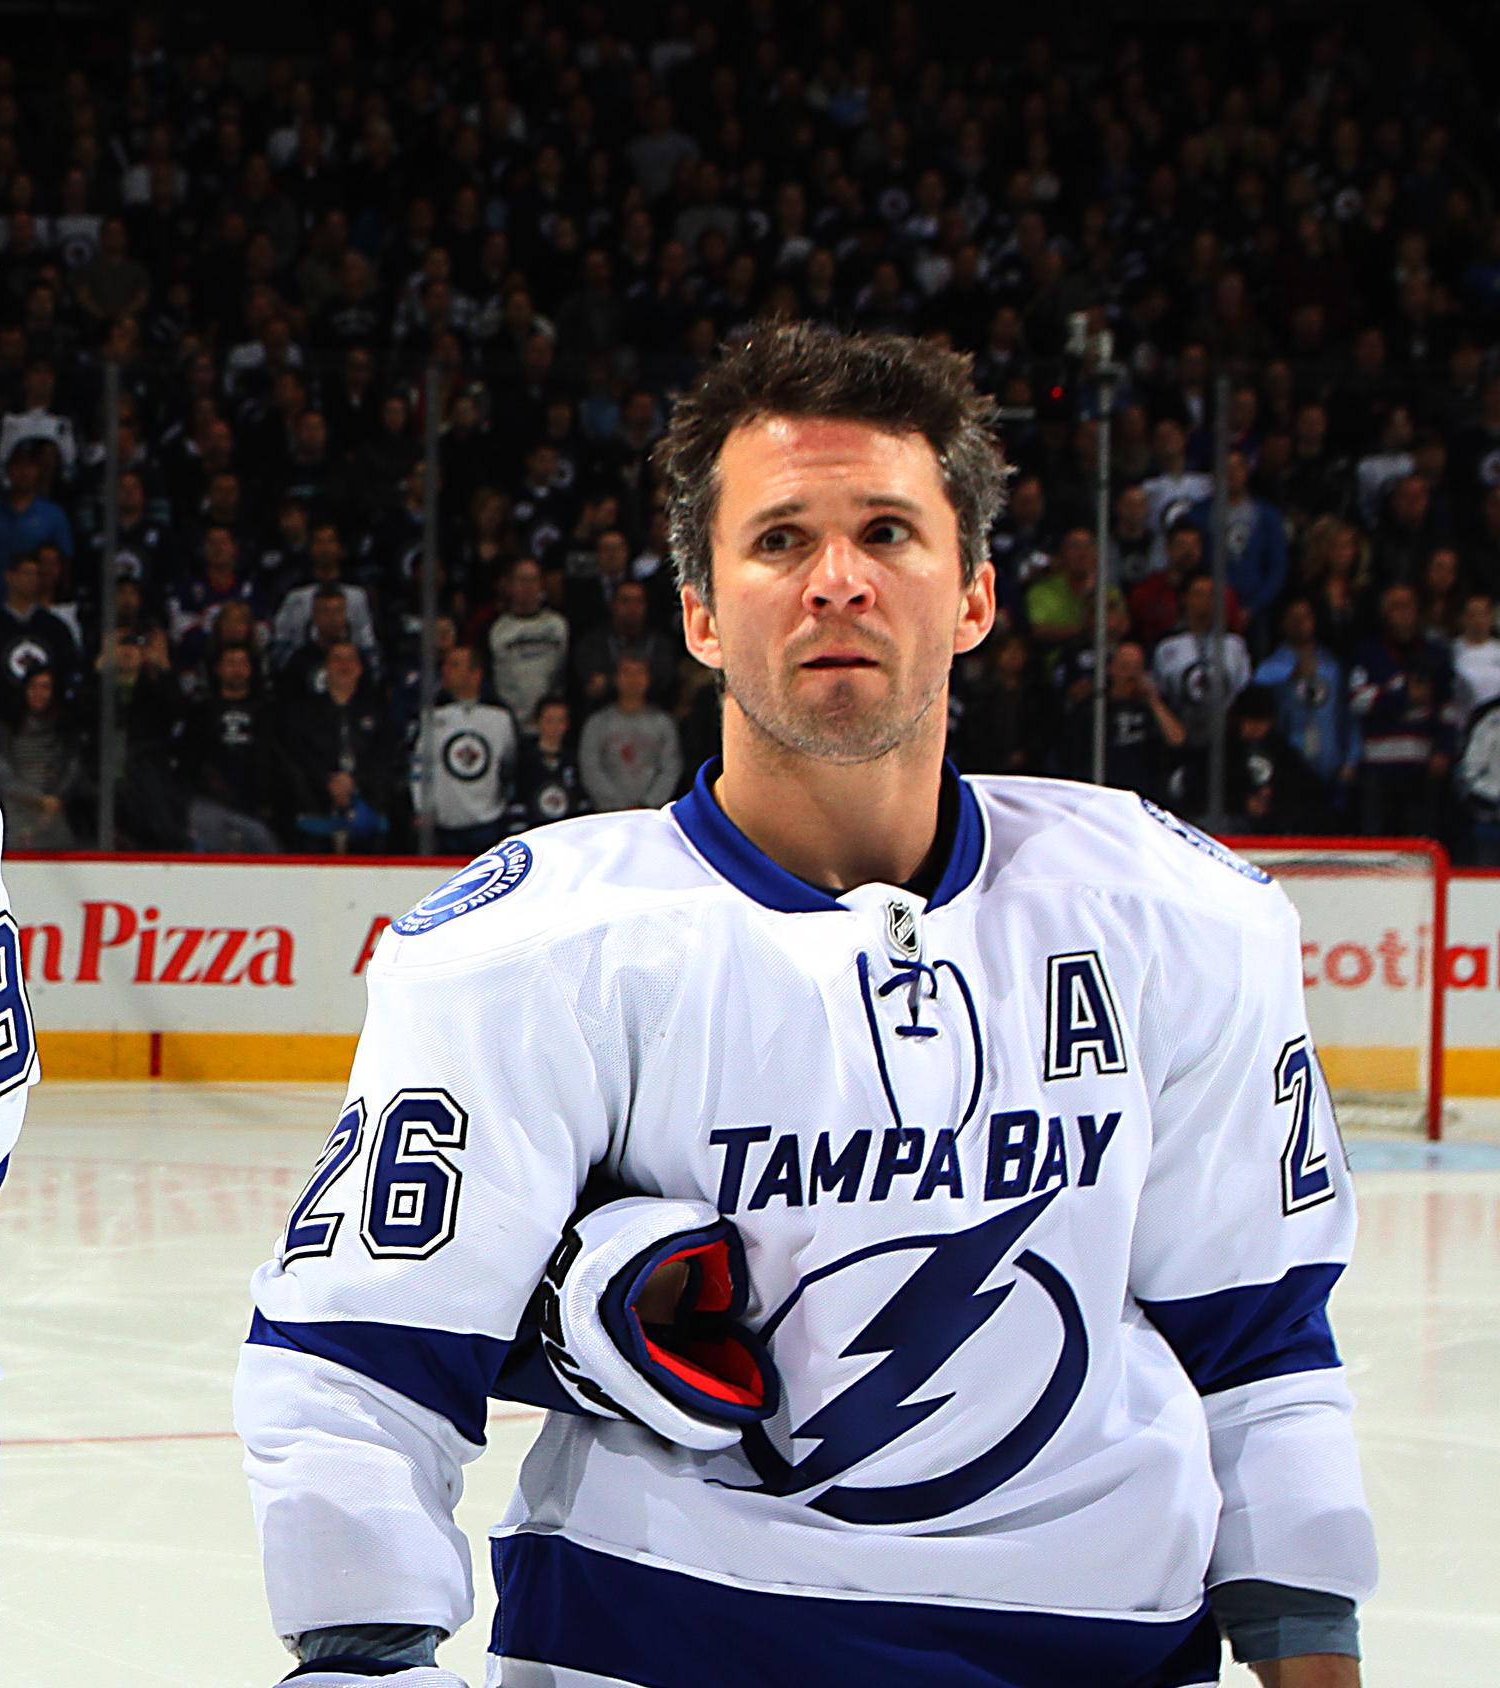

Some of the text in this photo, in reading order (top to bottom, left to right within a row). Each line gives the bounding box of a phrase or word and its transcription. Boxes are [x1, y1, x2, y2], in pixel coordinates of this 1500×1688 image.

[452, 842, 528, 915] LIGHTNING
[74, 901, 296, 988] Pizza
[1044, 950, 1128, 1082] A
[282, 1086, 469, 1270] 26
[708, 1110, 1122, 1216] TAMPA BAY
[1273, 1033, 1336, 1217] 2
